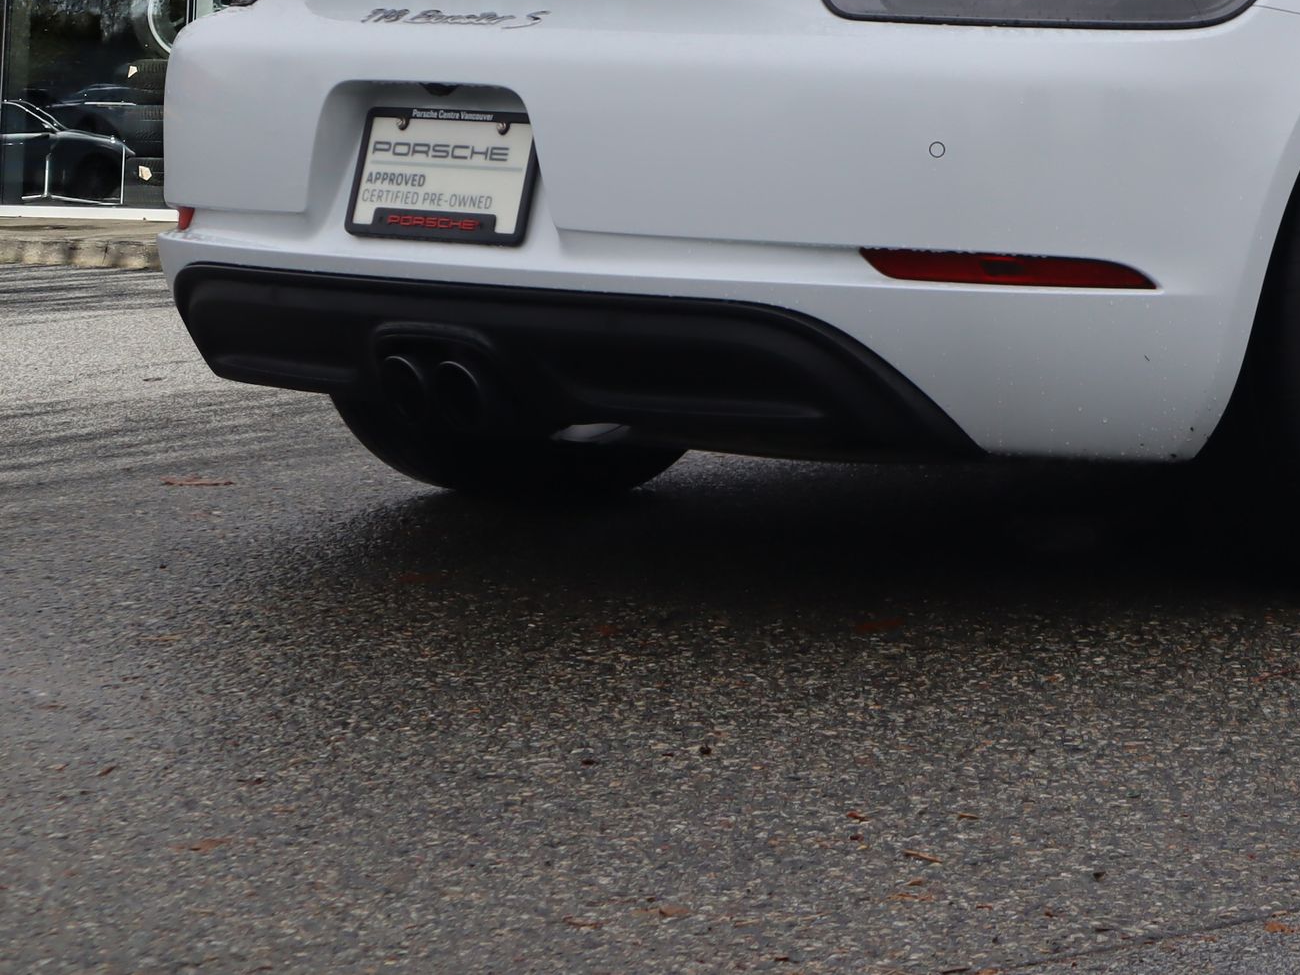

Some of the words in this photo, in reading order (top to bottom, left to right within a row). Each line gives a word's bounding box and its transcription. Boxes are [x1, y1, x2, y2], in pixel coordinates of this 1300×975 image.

[412, 108, 438, 118] Porsche
[438, 110, 460, 119] Centre
[460, 111, 494, 121] Vancouver
[372, 140, 510, 162] PORSCHE
[365, 171, 426, 187] APPROVED
[361, 188, 420, 205] CERTIFIED
[421, 192, 493, 210] PRE-OWNED
[386, 214, 480, 231] PORSCHE
